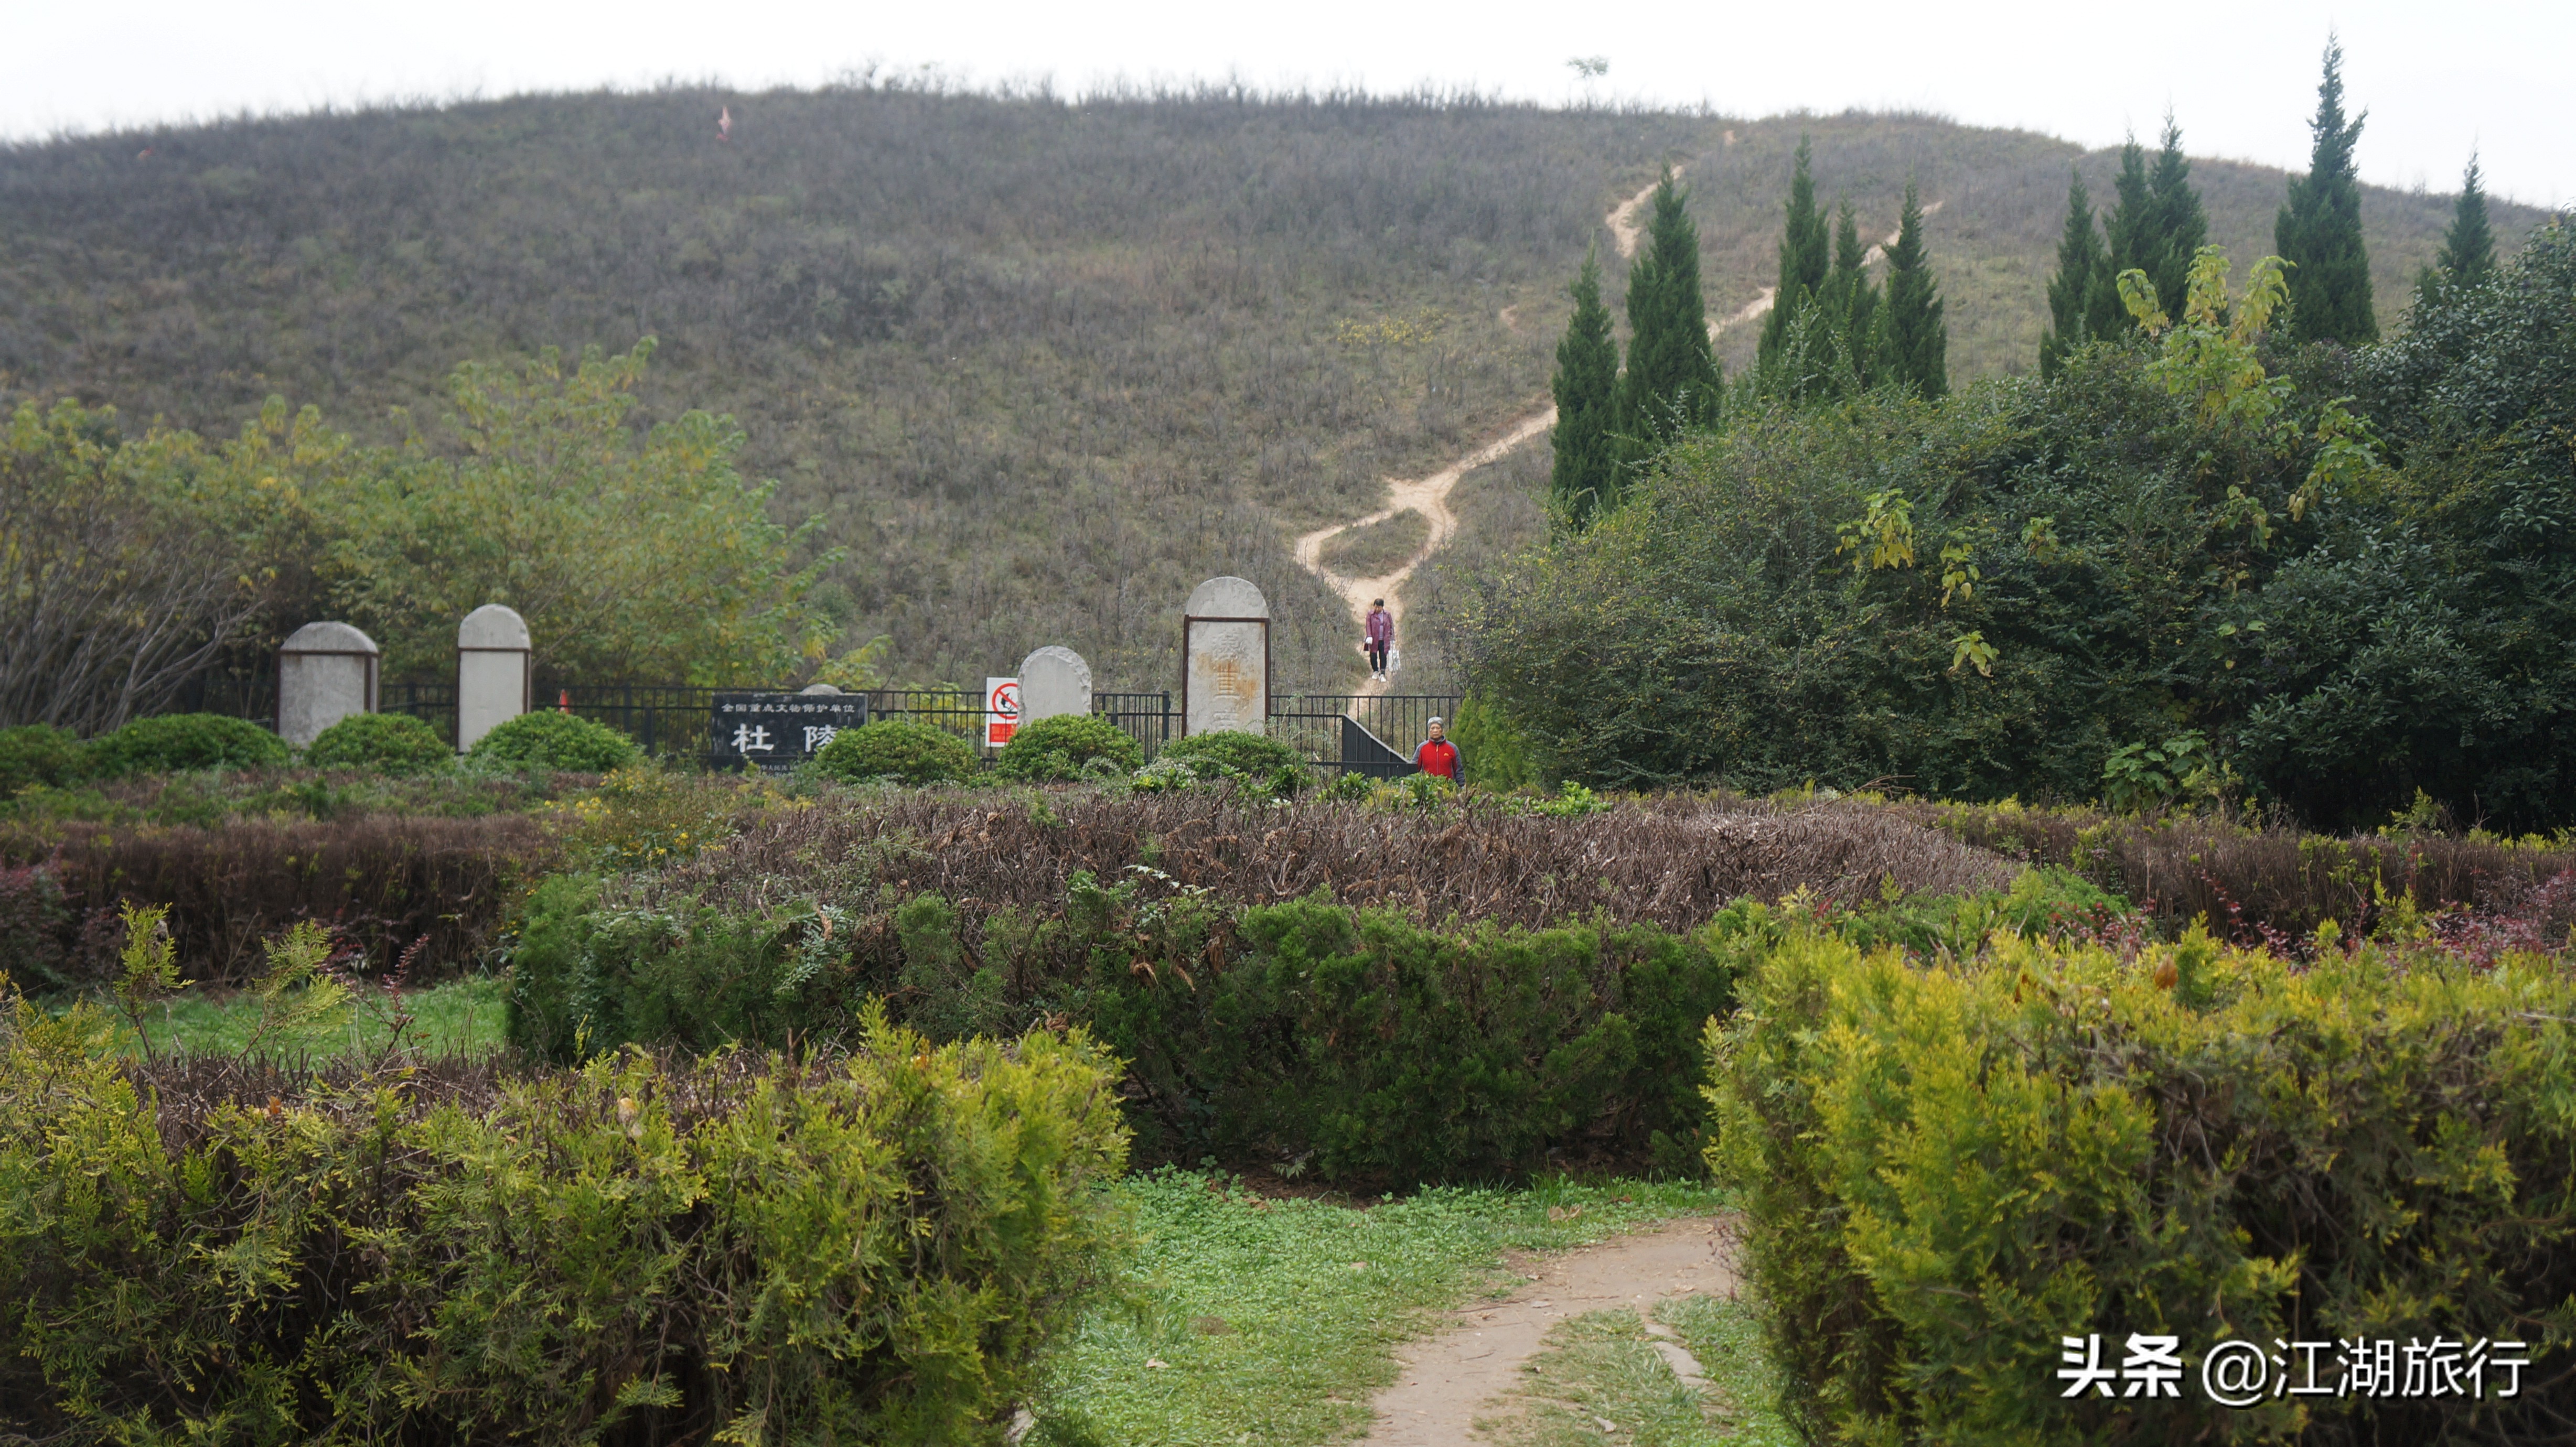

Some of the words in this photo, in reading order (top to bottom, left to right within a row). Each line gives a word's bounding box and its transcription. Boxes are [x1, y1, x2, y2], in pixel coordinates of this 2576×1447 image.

[721, 703, 855, 713] 全国重点文物保护单位
[731, 722, 839, 753] 杜陵
